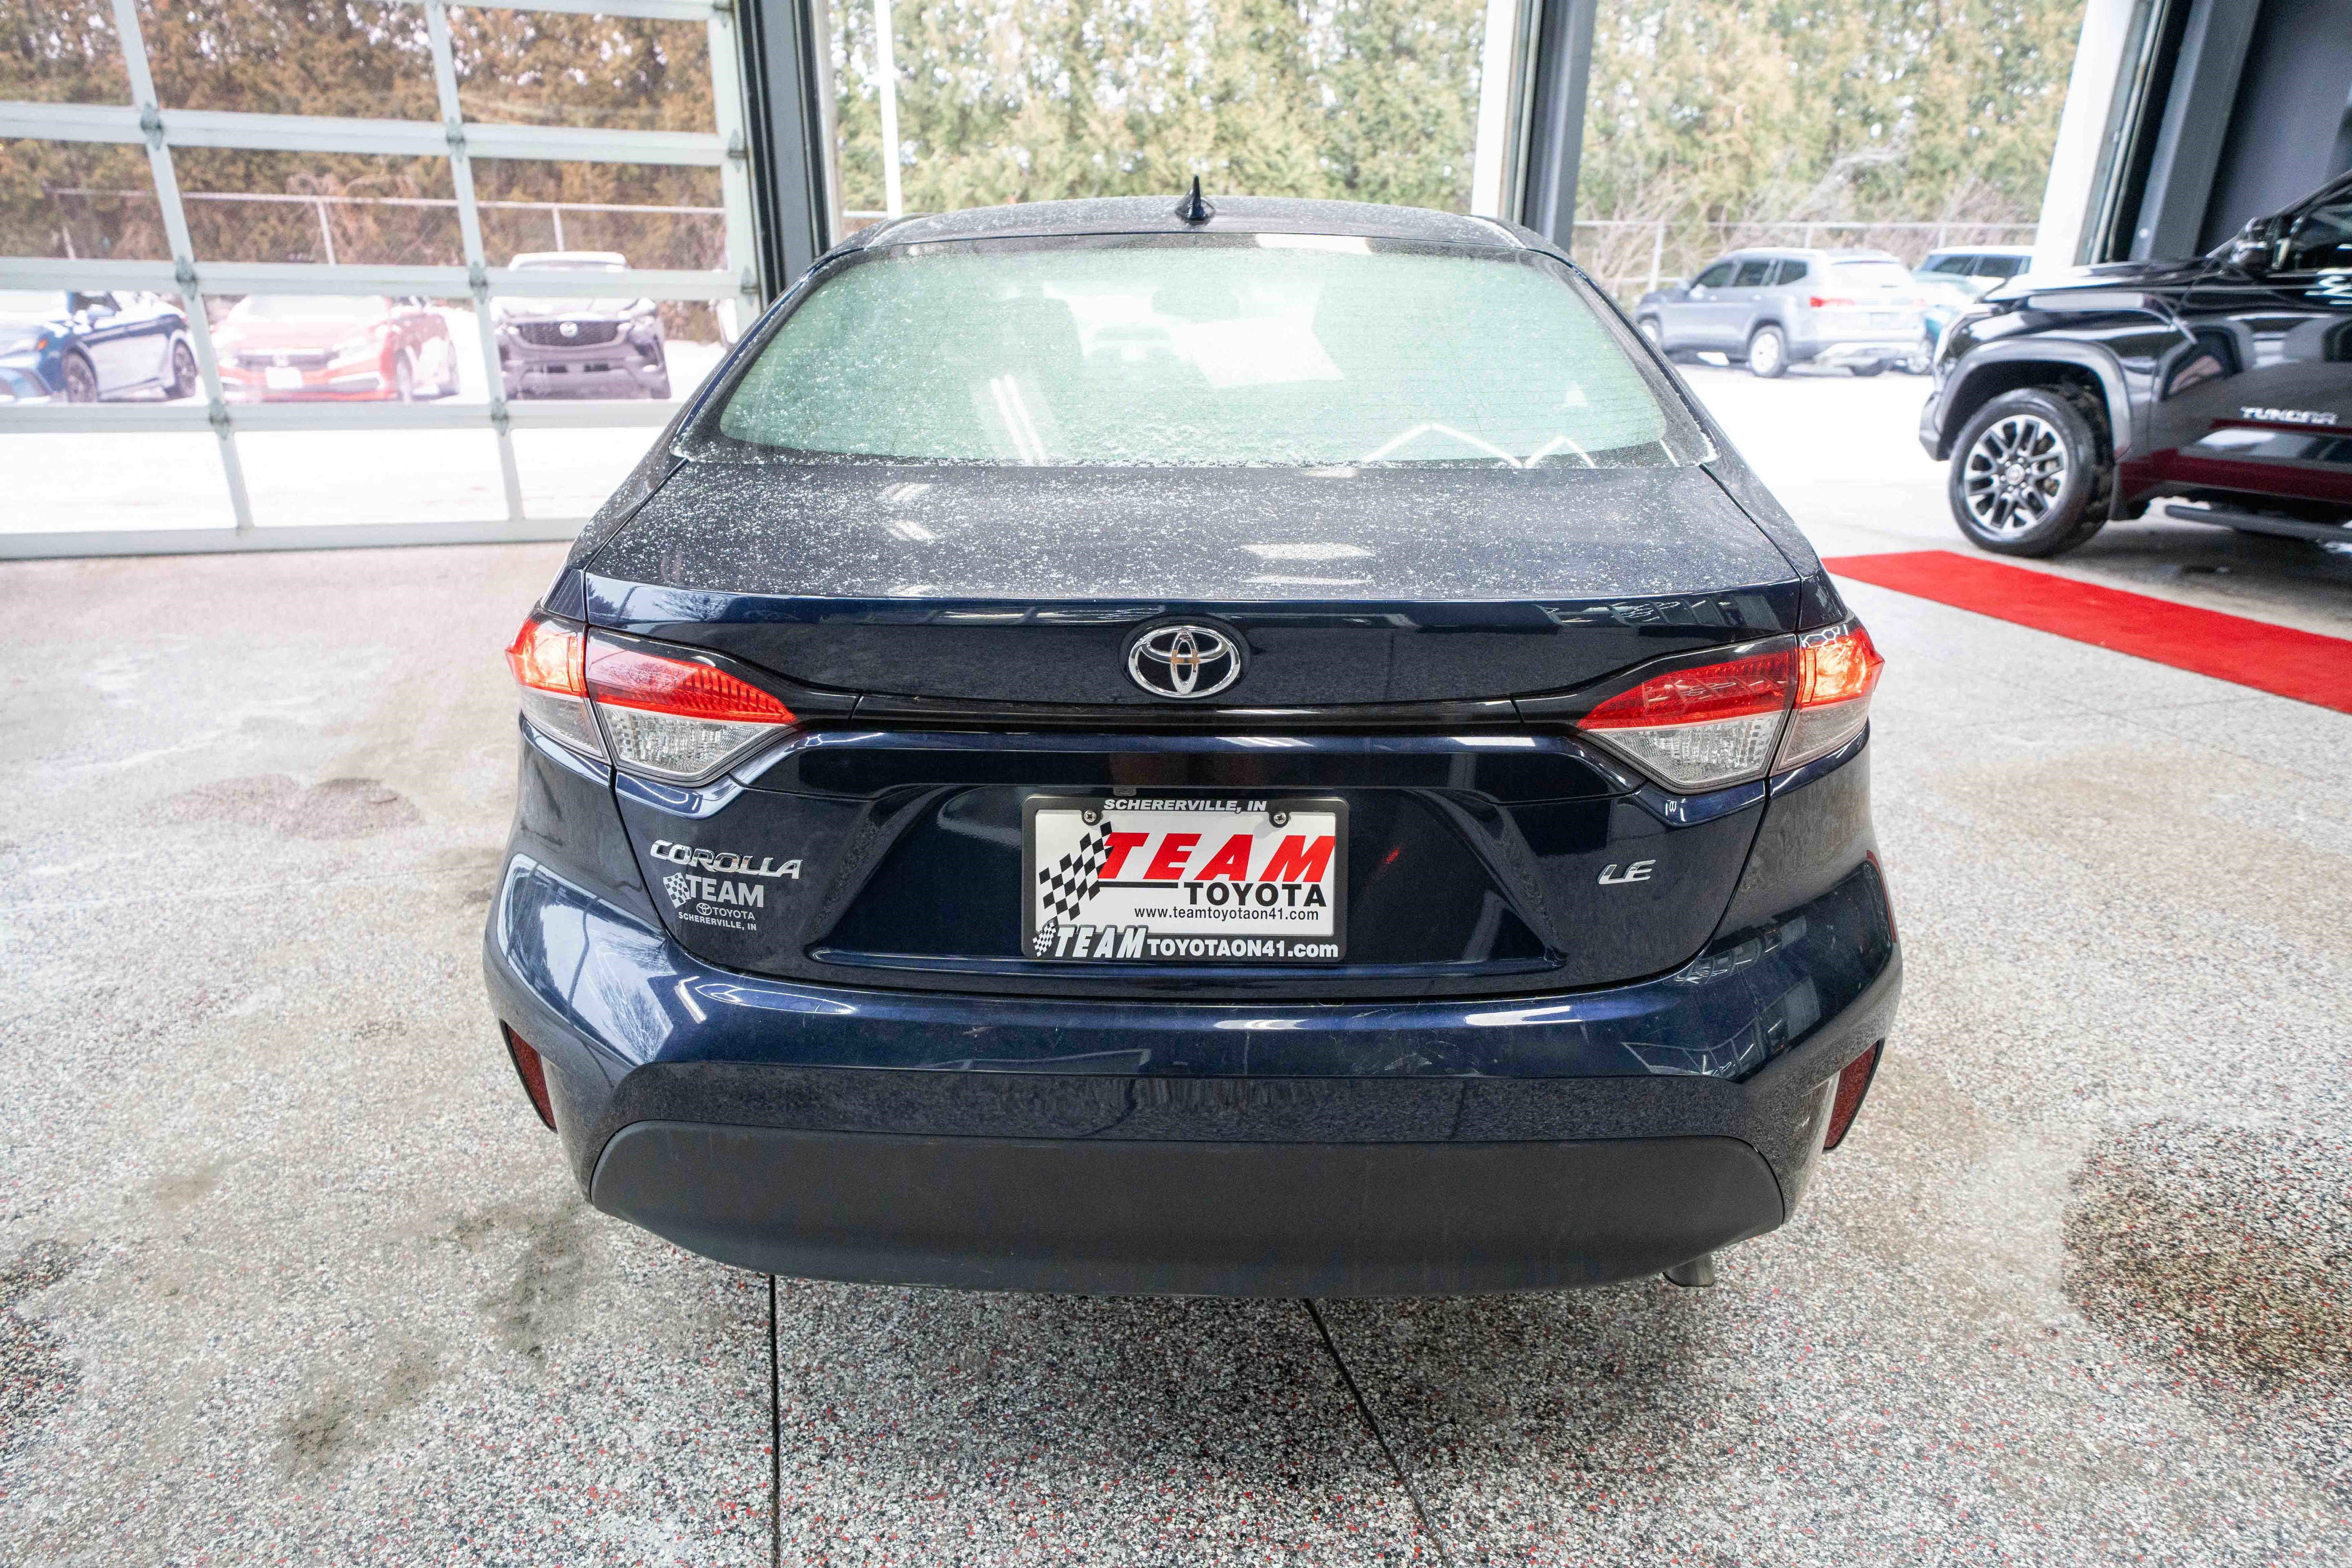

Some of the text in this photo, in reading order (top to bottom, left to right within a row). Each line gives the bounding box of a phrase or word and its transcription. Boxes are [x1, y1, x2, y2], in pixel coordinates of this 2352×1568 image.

[2240, 406, 2339, 425] TUNDRA
[1103, 799, 1267, 812] SCHERERVILLE, IN
[650, 840, 803, 880] COROLLA
[1098, 832, 1335, 882] TEAM
[1597, 859, 1656, 884] LE
[686, 874, 764, 907] TEAM
[1184, 882, 1327, 907] TOYOTA
[678, 911, 757, 931] SCHERERVILLE, IN
[712, 907, 755, 920] TOYOTA
[1134, 906, 1319, 922] www.teamtoyotaon41.com
[1055, 927, 1338, 958] TEAM TOYOTAON41.com
